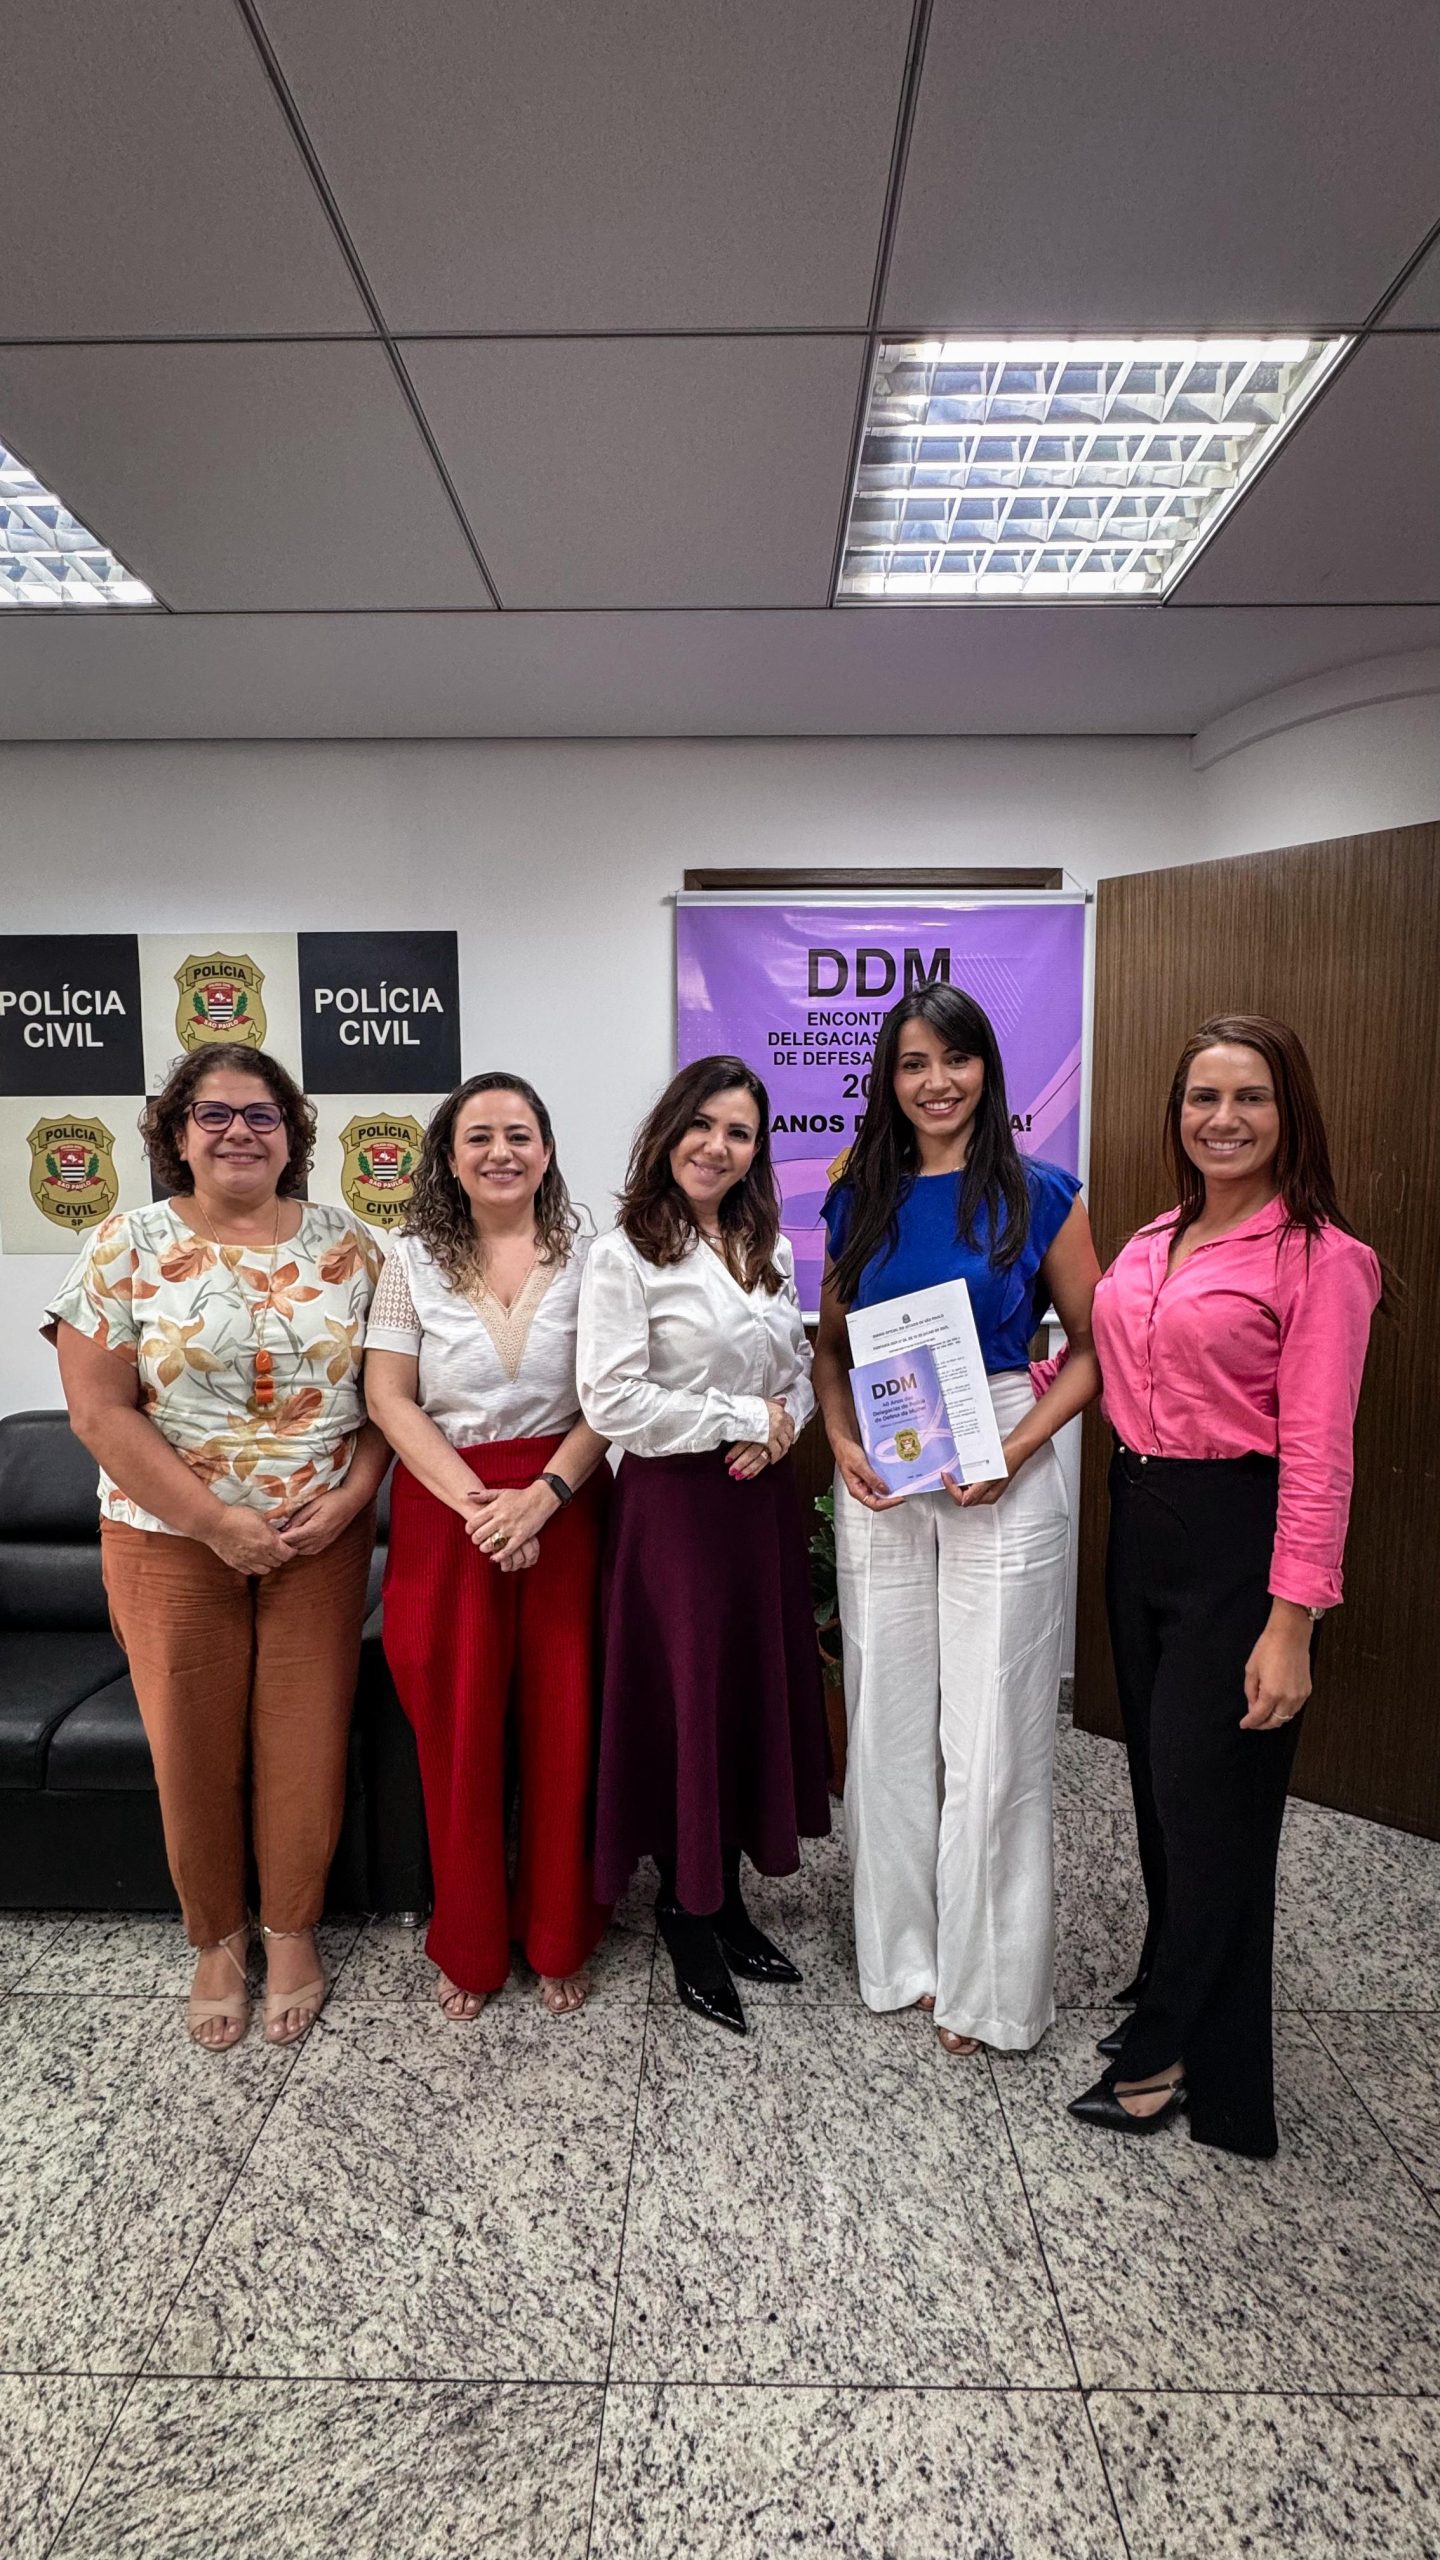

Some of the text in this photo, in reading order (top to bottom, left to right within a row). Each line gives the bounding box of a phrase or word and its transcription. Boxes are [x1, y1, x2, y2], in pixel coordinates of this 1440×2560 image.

[193, 962, 247, 980] POLÍCIA
[808, 948, 951, 998] DDM
[0, 983, 127, 1016] POLÍCIA
[314, 981, 444, 1014] POLÍCIA
[23, 1022, 104, 1048] CIVIL
[339, 1020, 420, 1045] CIVIL
[773, 1051, 873, 1065] DE DEFESA
[358, 1123, 411, 1141] POLÍCIA
[770, 1114, 845, 1133] ANOS
[45, 1124, 98, 1142] POLÍCIA
[55, 1203, 98, 1216] CIVIL
[71, 1218, 83, 1226] SP
[381, 1217, 394, 1225] SP
[871, 1373, 917, 1400] DDM
